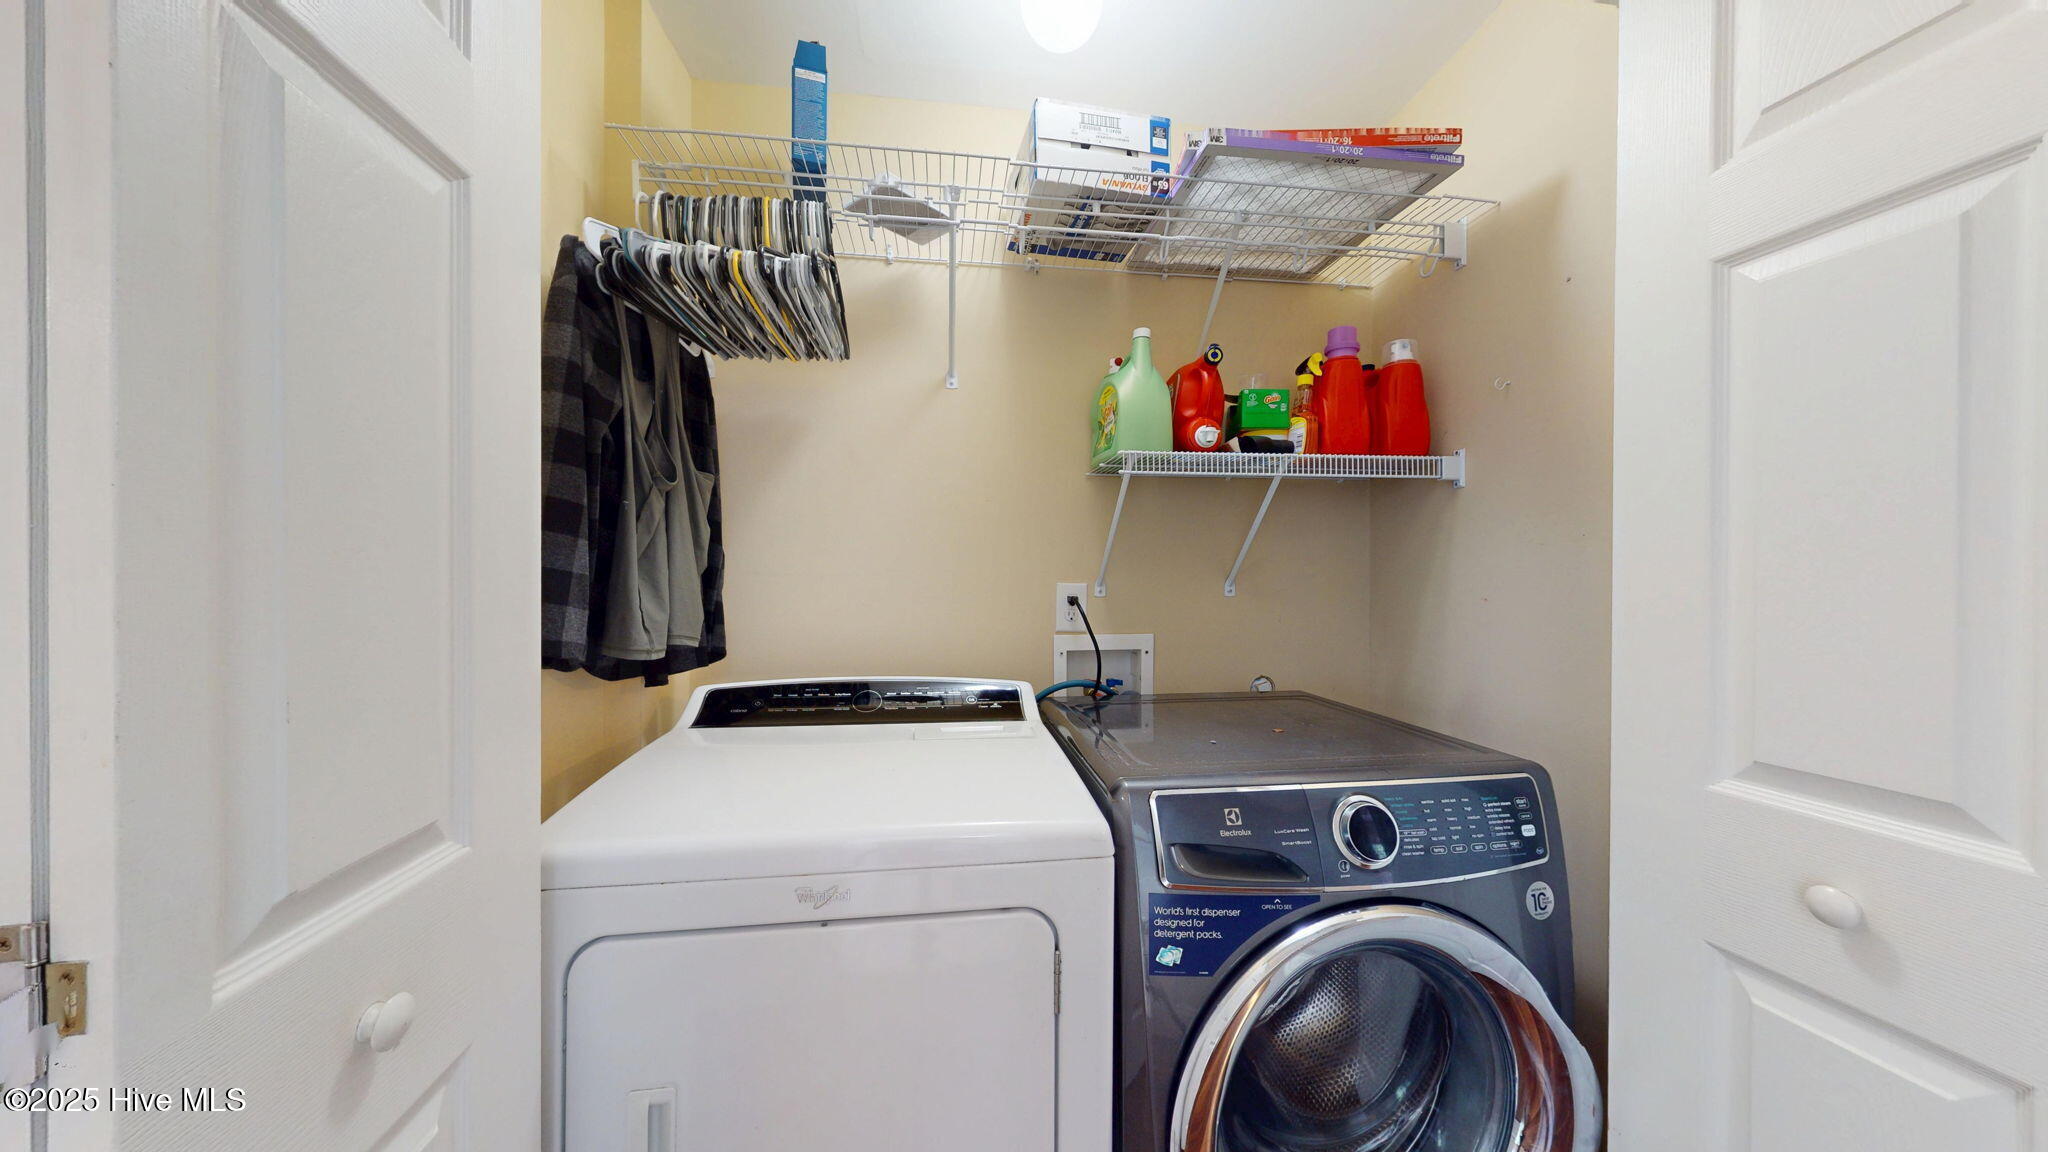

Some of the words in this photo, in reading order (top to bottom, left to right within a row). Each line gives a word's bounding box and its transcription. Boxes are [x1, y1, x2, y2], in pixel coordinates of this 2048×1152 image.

[1188, 138, 1202, 148] 3M
[1209, 135, 1224, 144] 3M
[1264, 394, 1281, 404] Gain
[1220, 829, 1252, 837] Electrolux
[1154, 906, 1184, 916] World's
[1185, 907, 1200, 916] first
[1201, 907, 1241, 918] dispenser
[1154, 918, 1193, 928] designed
[1193, 918, 1205, 927] for
[1154, 929, 1195, 940] detergent
[1196, 930, 1223, 940] packs.
